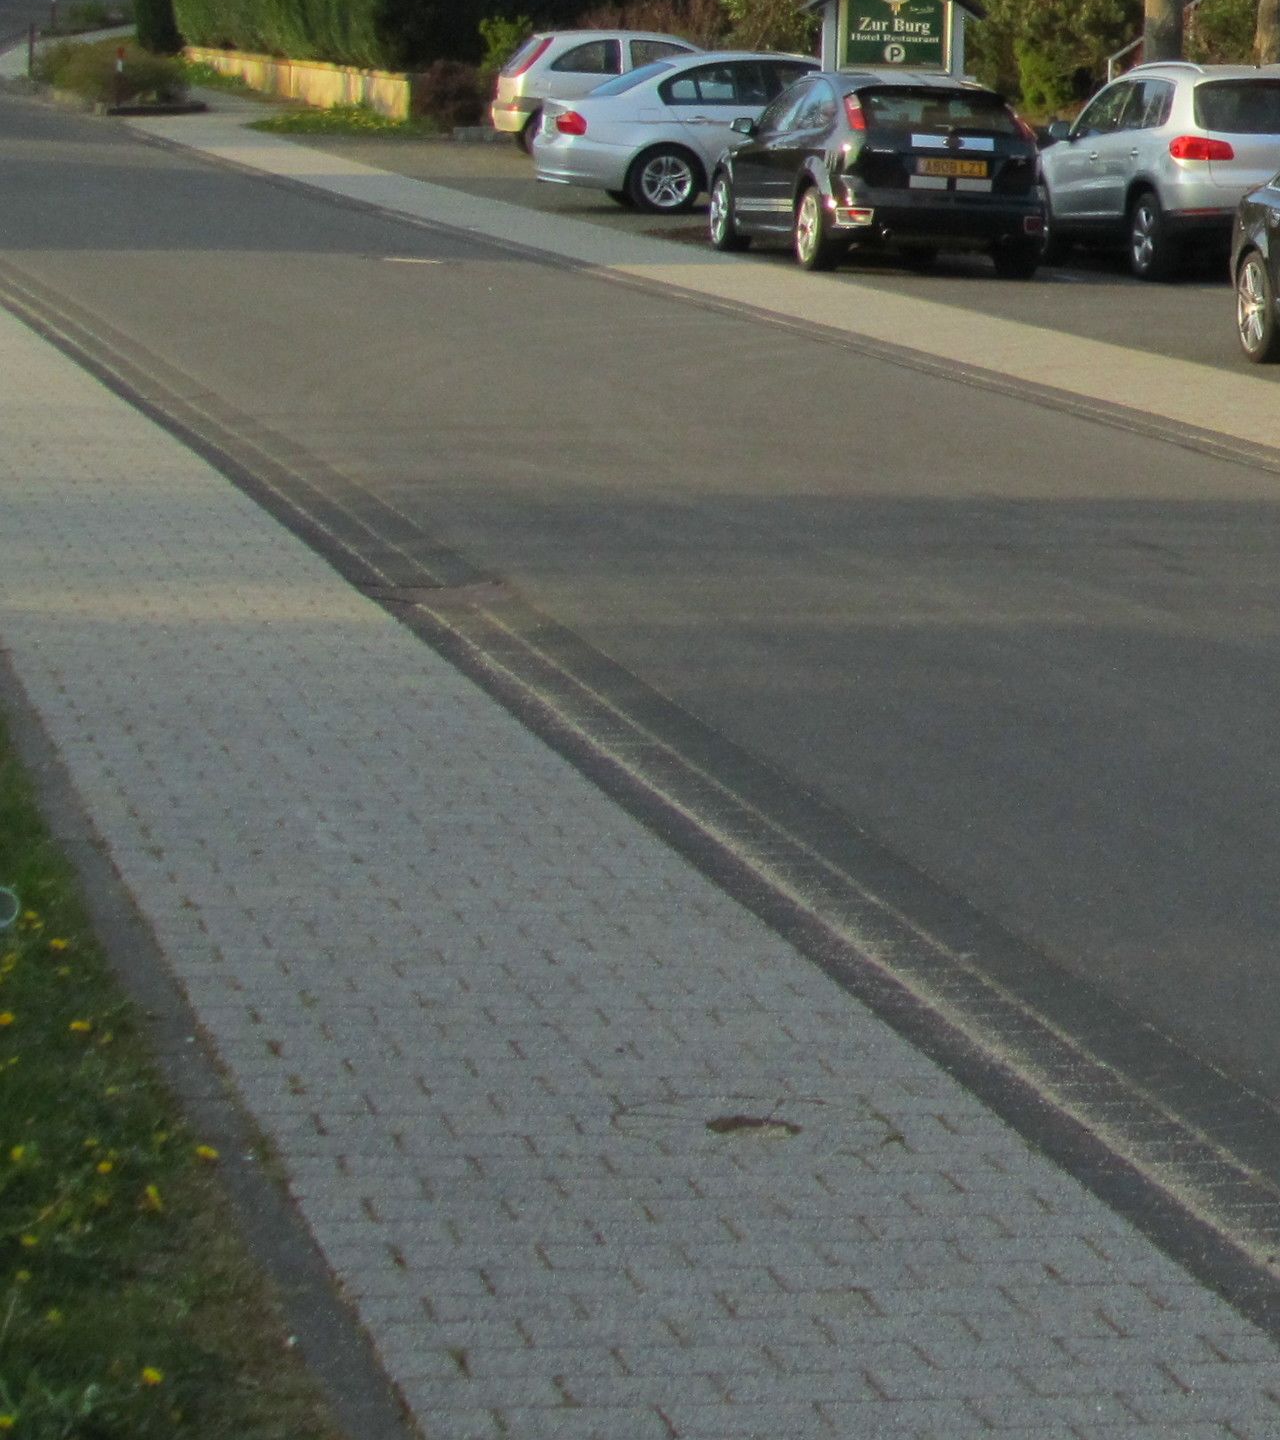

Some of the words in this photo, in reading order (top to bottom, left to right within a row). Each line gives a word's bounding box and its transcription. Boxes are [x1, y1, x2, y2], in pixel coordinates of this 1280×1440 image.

[859, 17, 888, 32] Zur
[893, 18, 930, 36] Burg
[851, 33, 880, 41] Hotel
[883, 34, 939, 43] Restaurant
